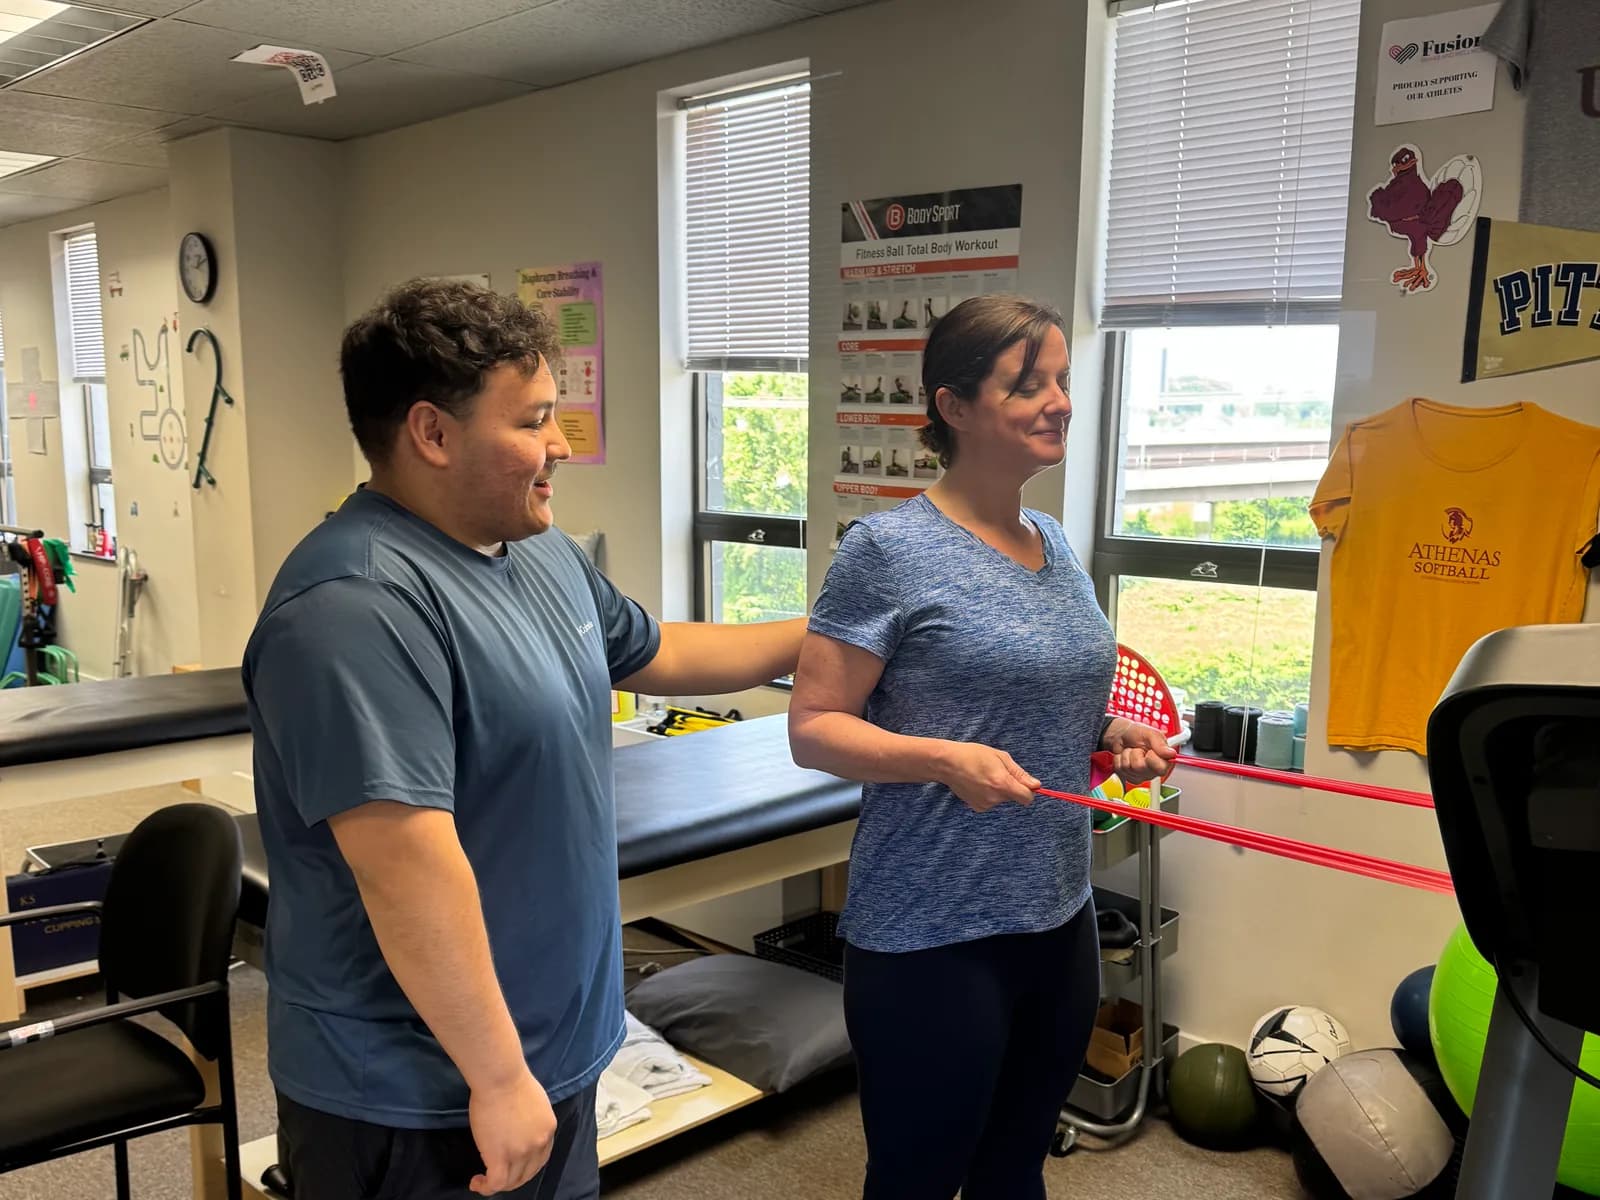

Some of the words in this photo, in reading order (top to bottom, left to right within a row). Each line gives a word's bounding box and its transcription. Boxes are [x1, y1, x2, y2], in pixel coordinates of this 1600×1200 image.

[1393, 79, 1428, 91] PROUDLY
[1430, 71, 1478, 87] SUPPORTING
[1406, 92, 1424, 101] OUR
[1426, 86, 1463, 99] ATHLETES
[856, 248, 885, 260] Fitness
[886, 245, 904, 257] Ball
[907, 243, 929, 256] Total
[931, 241, 952, 256] Body
[955, 239, 998, 251] Workout
[883, 264, 916, 275] STRETCH
[1493, 262, 1600, 336] PIT
[841, 342, 860, 351] CORE
[839, 414, 862, 424] LOWER
[864, 414, 881, 423] BODY
[836, 484, 859, 494] UPPER
[860, 485, 878, 495] BODY
[1408, 542, 1501, 567] ATHENAS
[1414, 561, 1490, 580] SOFTBALL
[44, 918, 93, 934] CUPPING
